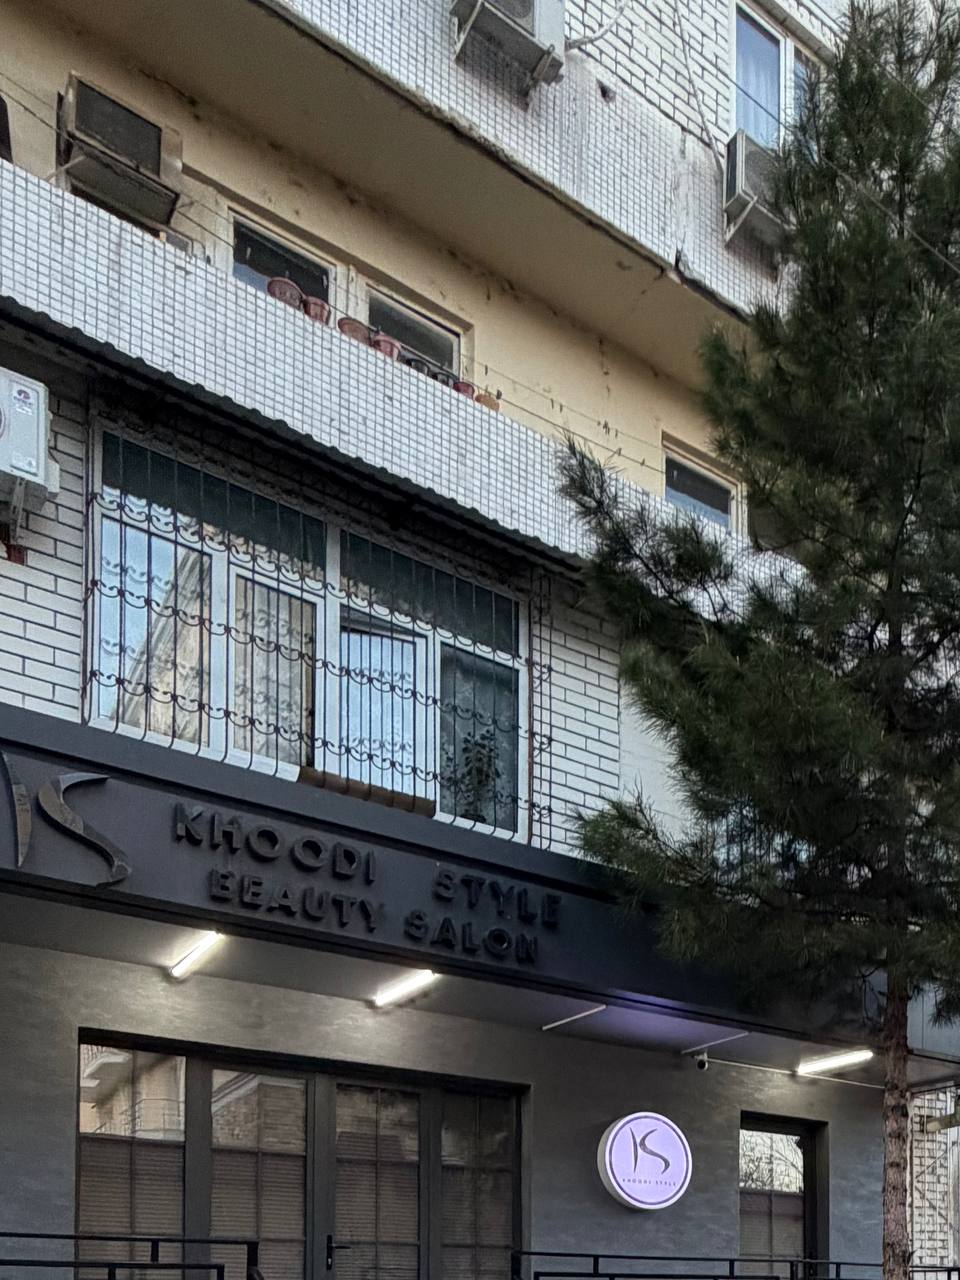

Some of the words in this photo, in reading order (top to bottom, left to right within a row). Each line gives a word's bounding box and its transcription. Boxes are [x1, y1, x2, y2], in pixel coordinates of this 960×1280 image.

[173, 803, 377, 884] KHOODI
[434, 871, 561, 928] STYLE
[209, 869, 386, 933] BEAUTY
[406, 911, 538, 963] SALON
